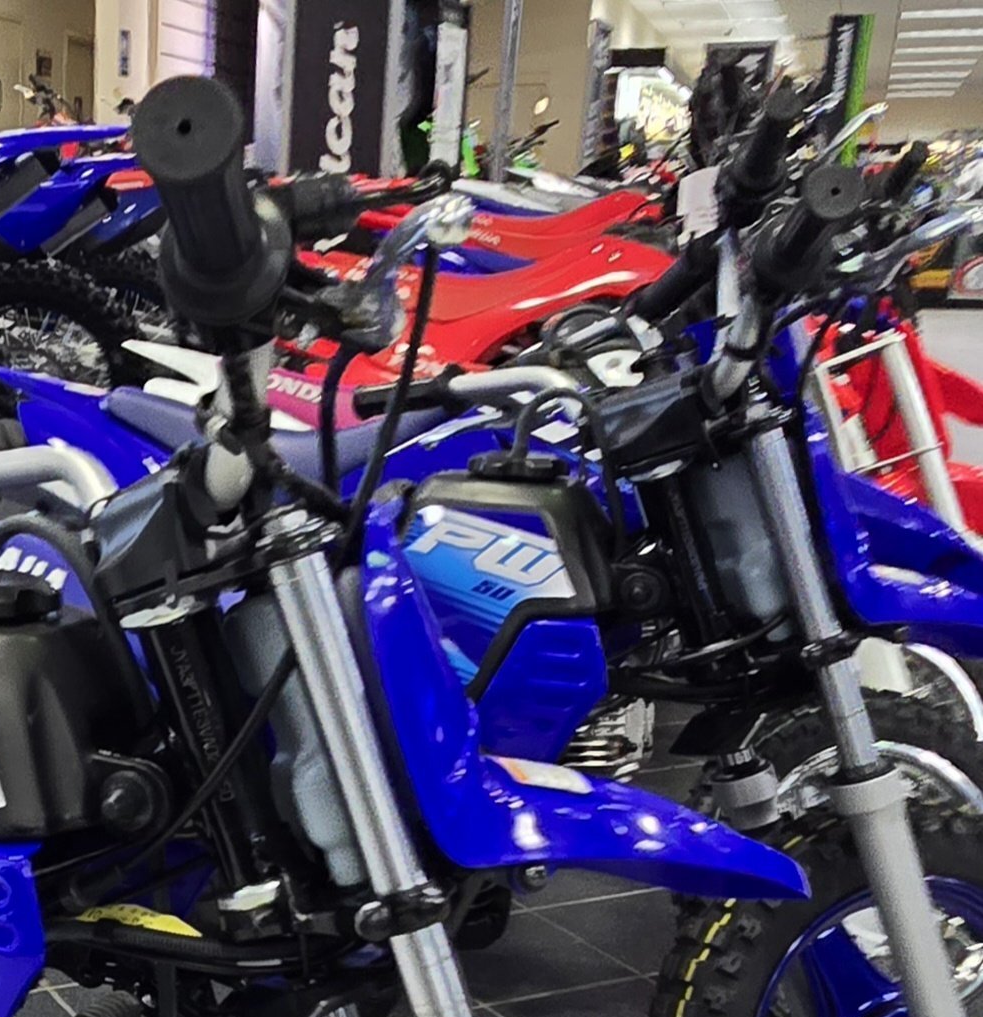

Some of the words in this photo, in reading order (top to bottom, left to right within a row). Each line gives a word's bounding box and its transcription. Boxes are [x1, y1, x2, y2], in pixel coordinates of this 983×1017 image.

[267, 373, 322, 403] OND
[406, 520, 566, 586] PW
[471, 579, 516, 601] 50
